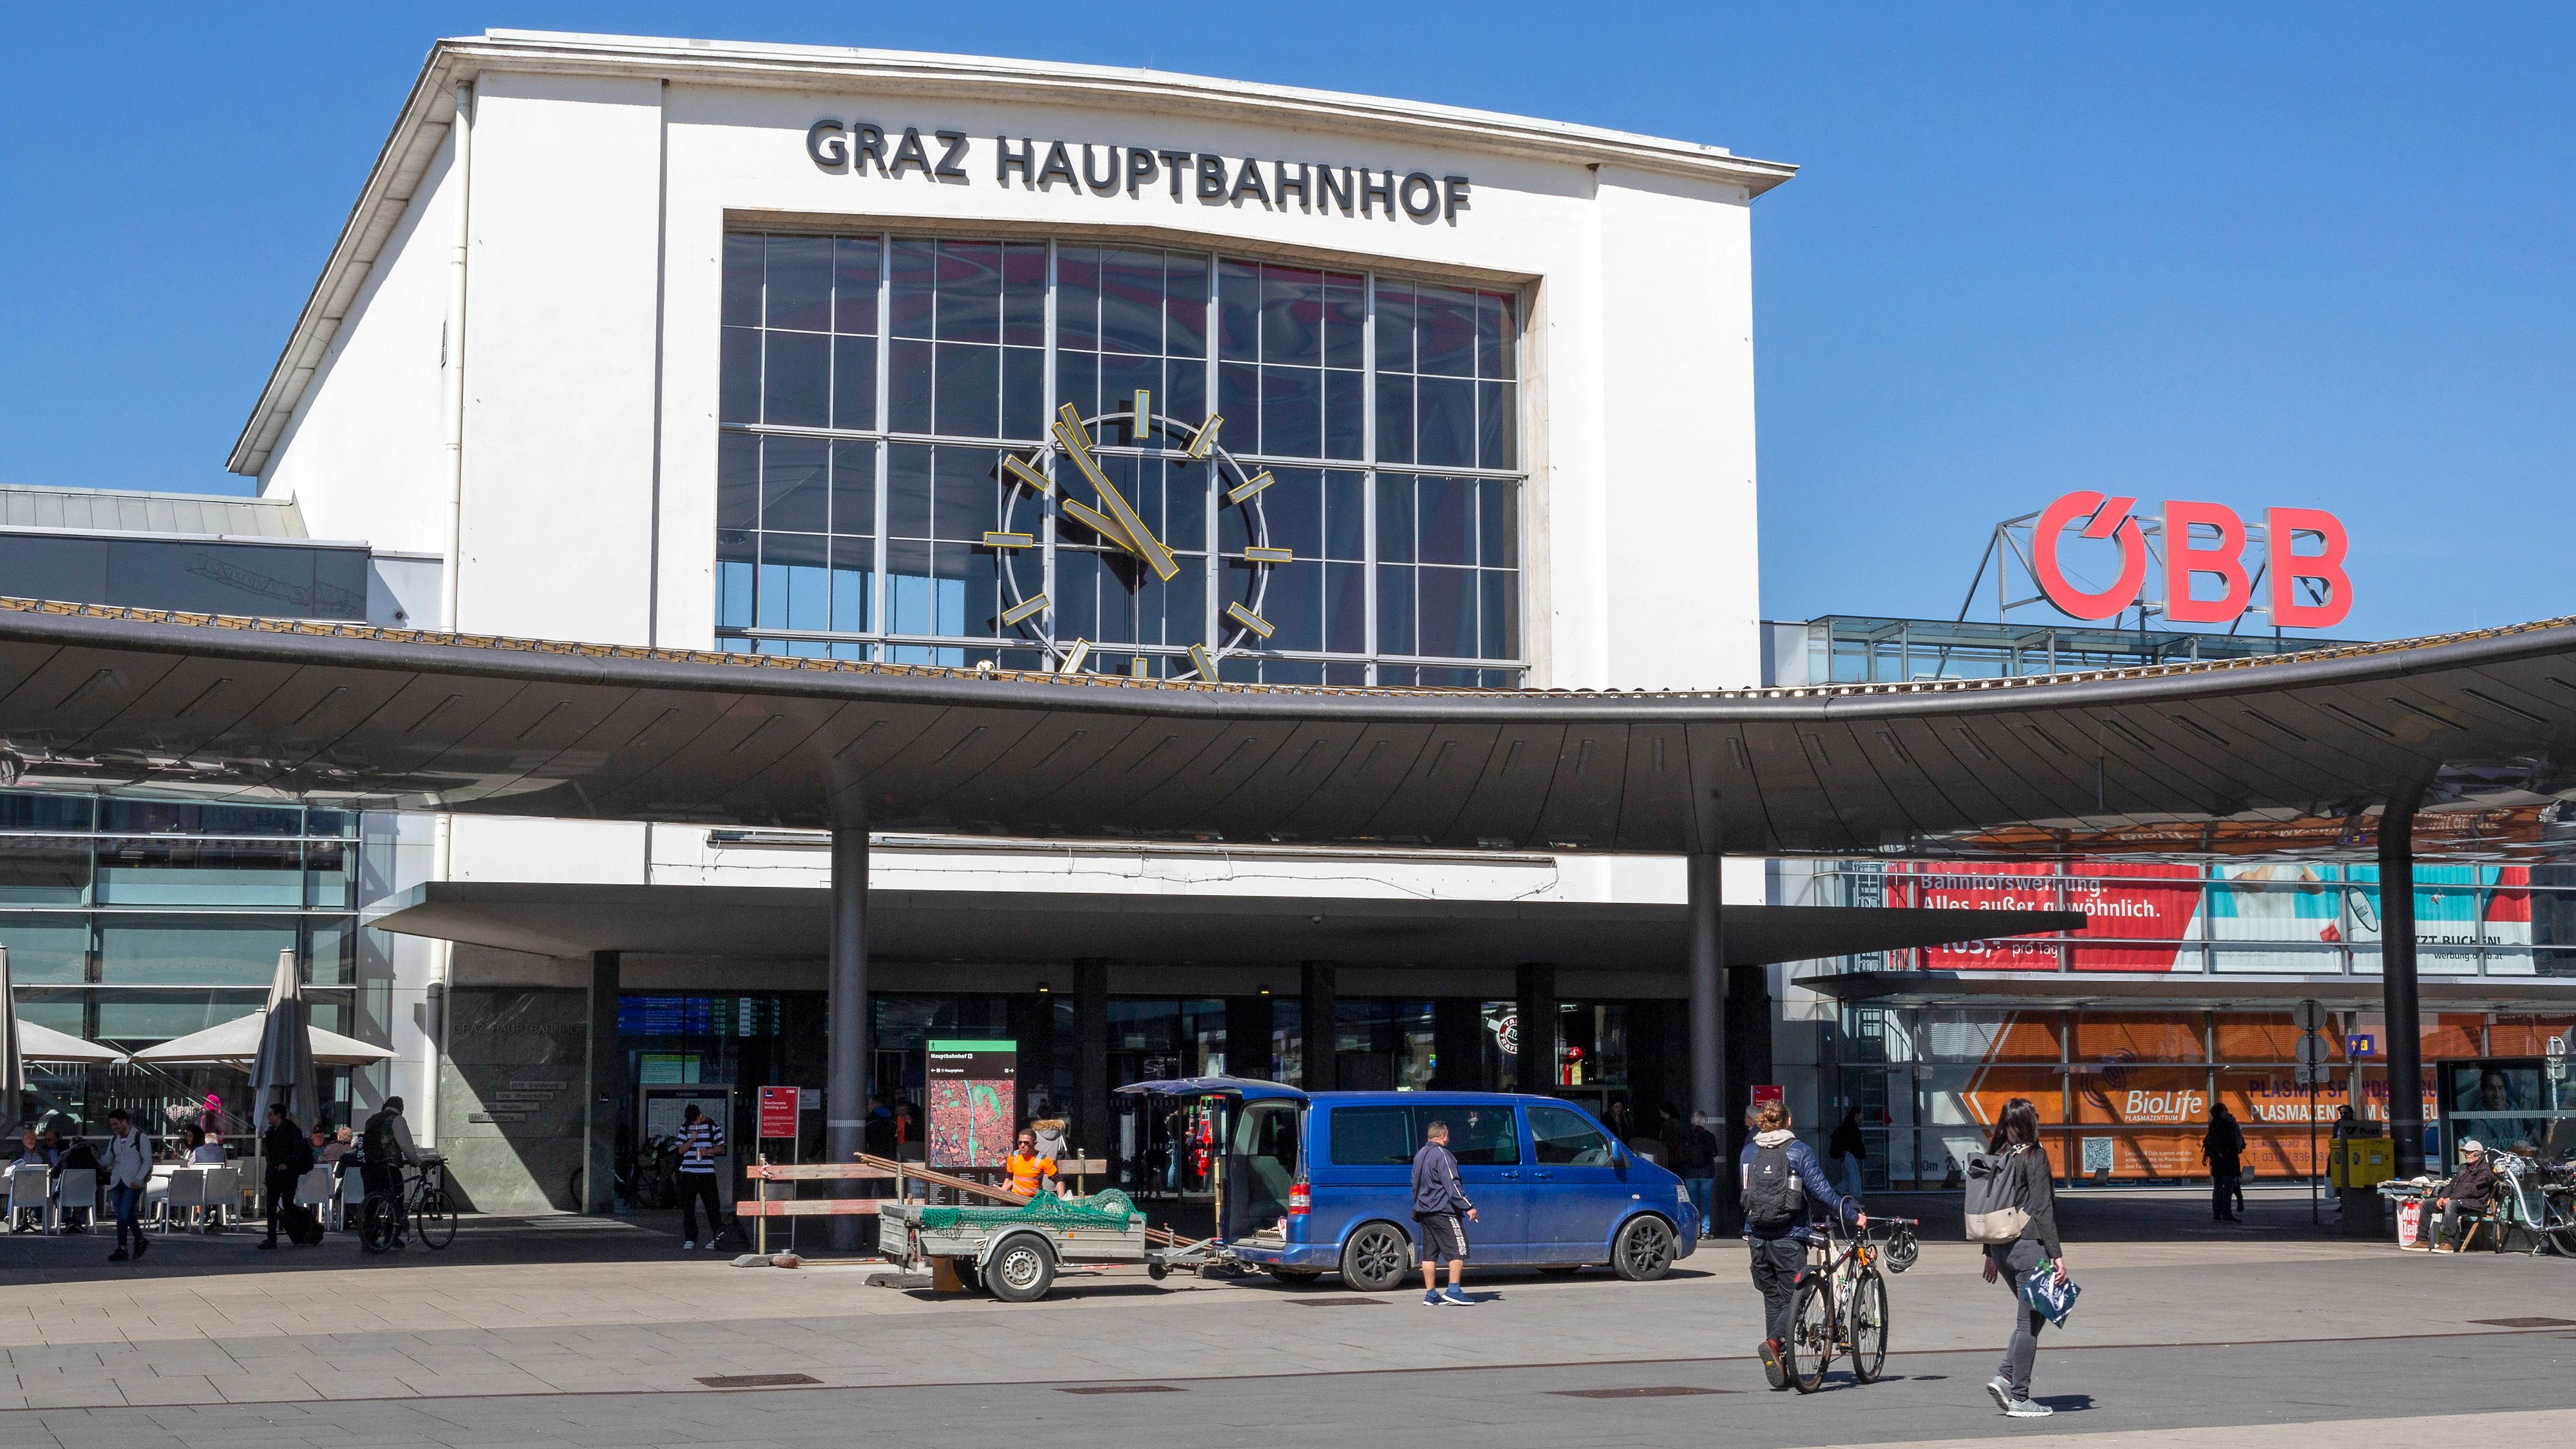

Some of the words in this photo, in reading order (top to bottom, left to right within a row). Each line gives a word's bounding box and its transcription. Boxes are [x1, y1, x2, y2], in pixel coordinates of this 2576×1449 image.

[806, 118, 967, 178] GRAZ
[996, 135, 1469, 221] HAUPTBAHNHOF
[2029, 490, 2353, 628] ÖBB
[2043, 898, 2161, 918] gwöhnlich.
[2012, 943, 2033, 958] pro
[2037, 942, 2058, 958] Tag
[2443, 935, 2501, 945] BUCHN!
[2126, 1089, 2202, 1121] BioLife
[2293, 1153, 2310, 1162] 339
